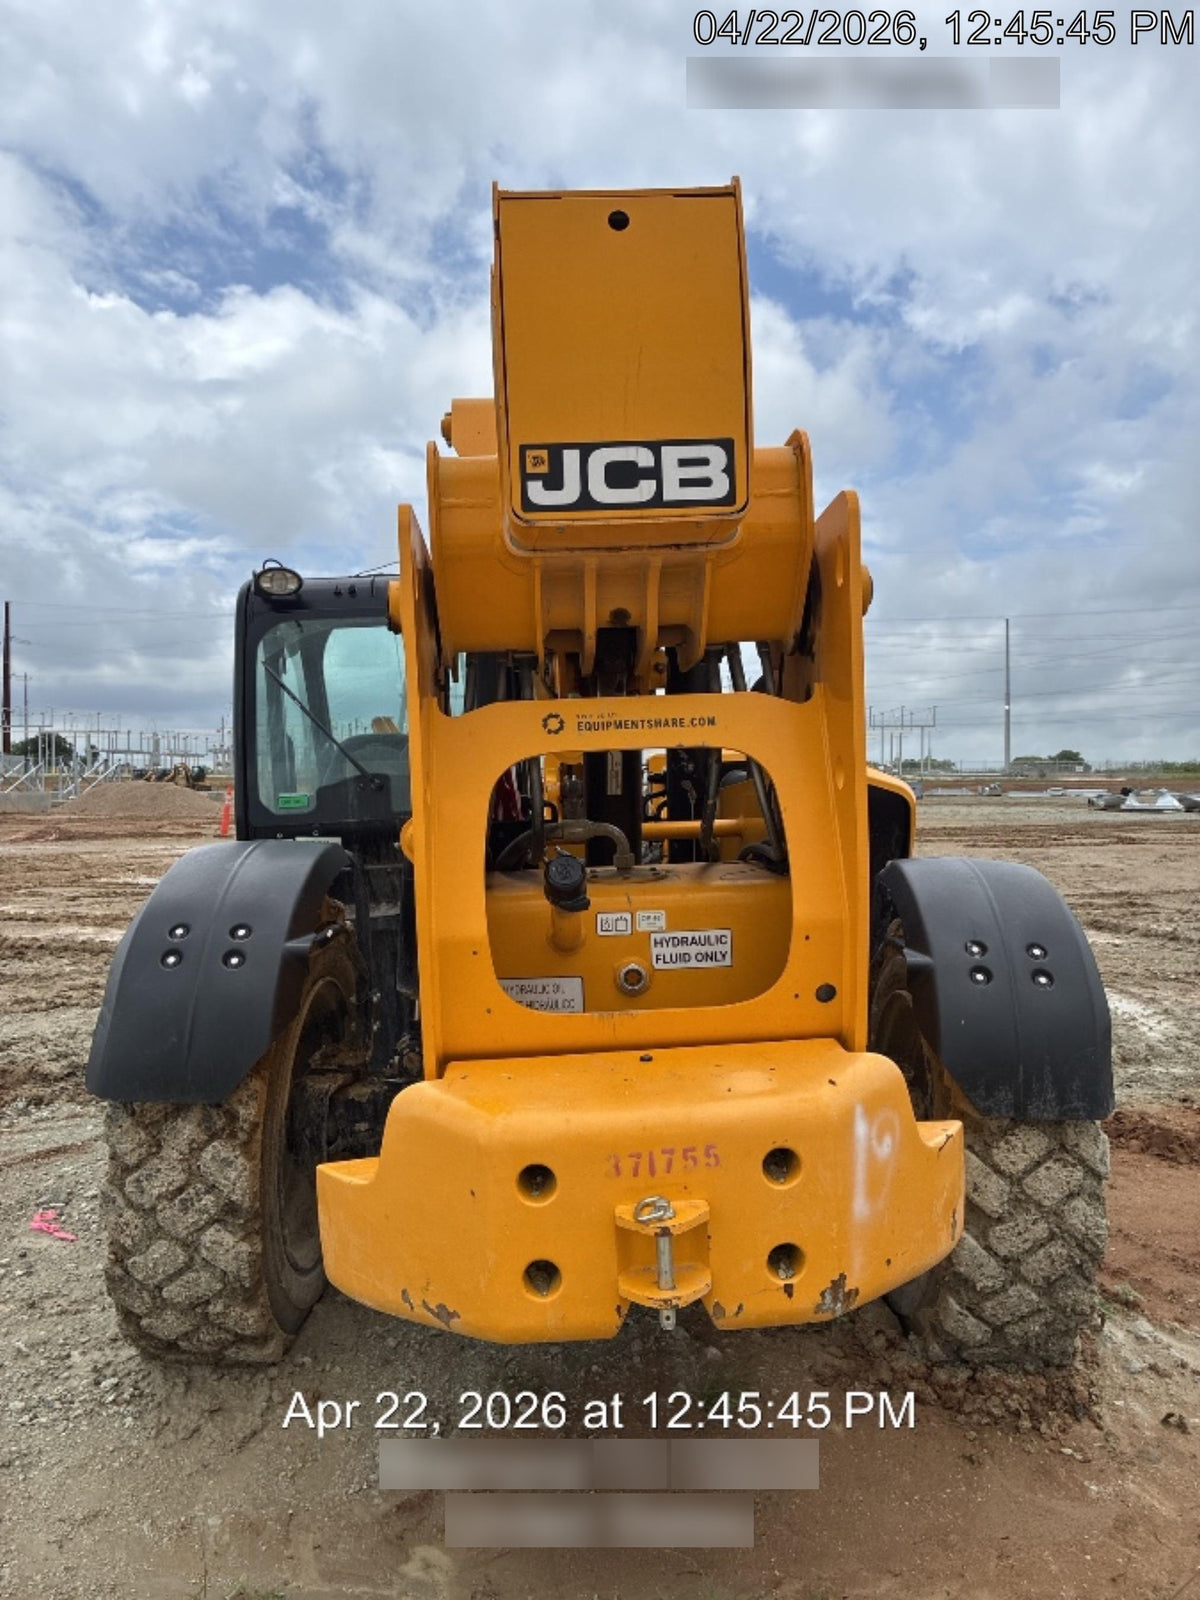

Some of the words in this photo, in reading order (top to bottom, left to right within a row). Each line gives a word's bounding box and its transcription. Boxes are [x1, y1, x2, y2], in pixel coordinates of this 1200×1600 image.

[526, 444, 730, 506] JCB
[577, 716, 716, 732] EQUIPMENTSHARE.COM
[653, 934, 728, 949] HYDRAULIC
[655, 952, 691, 965] FLUID
[695, 950, 728, 964] ONLY
